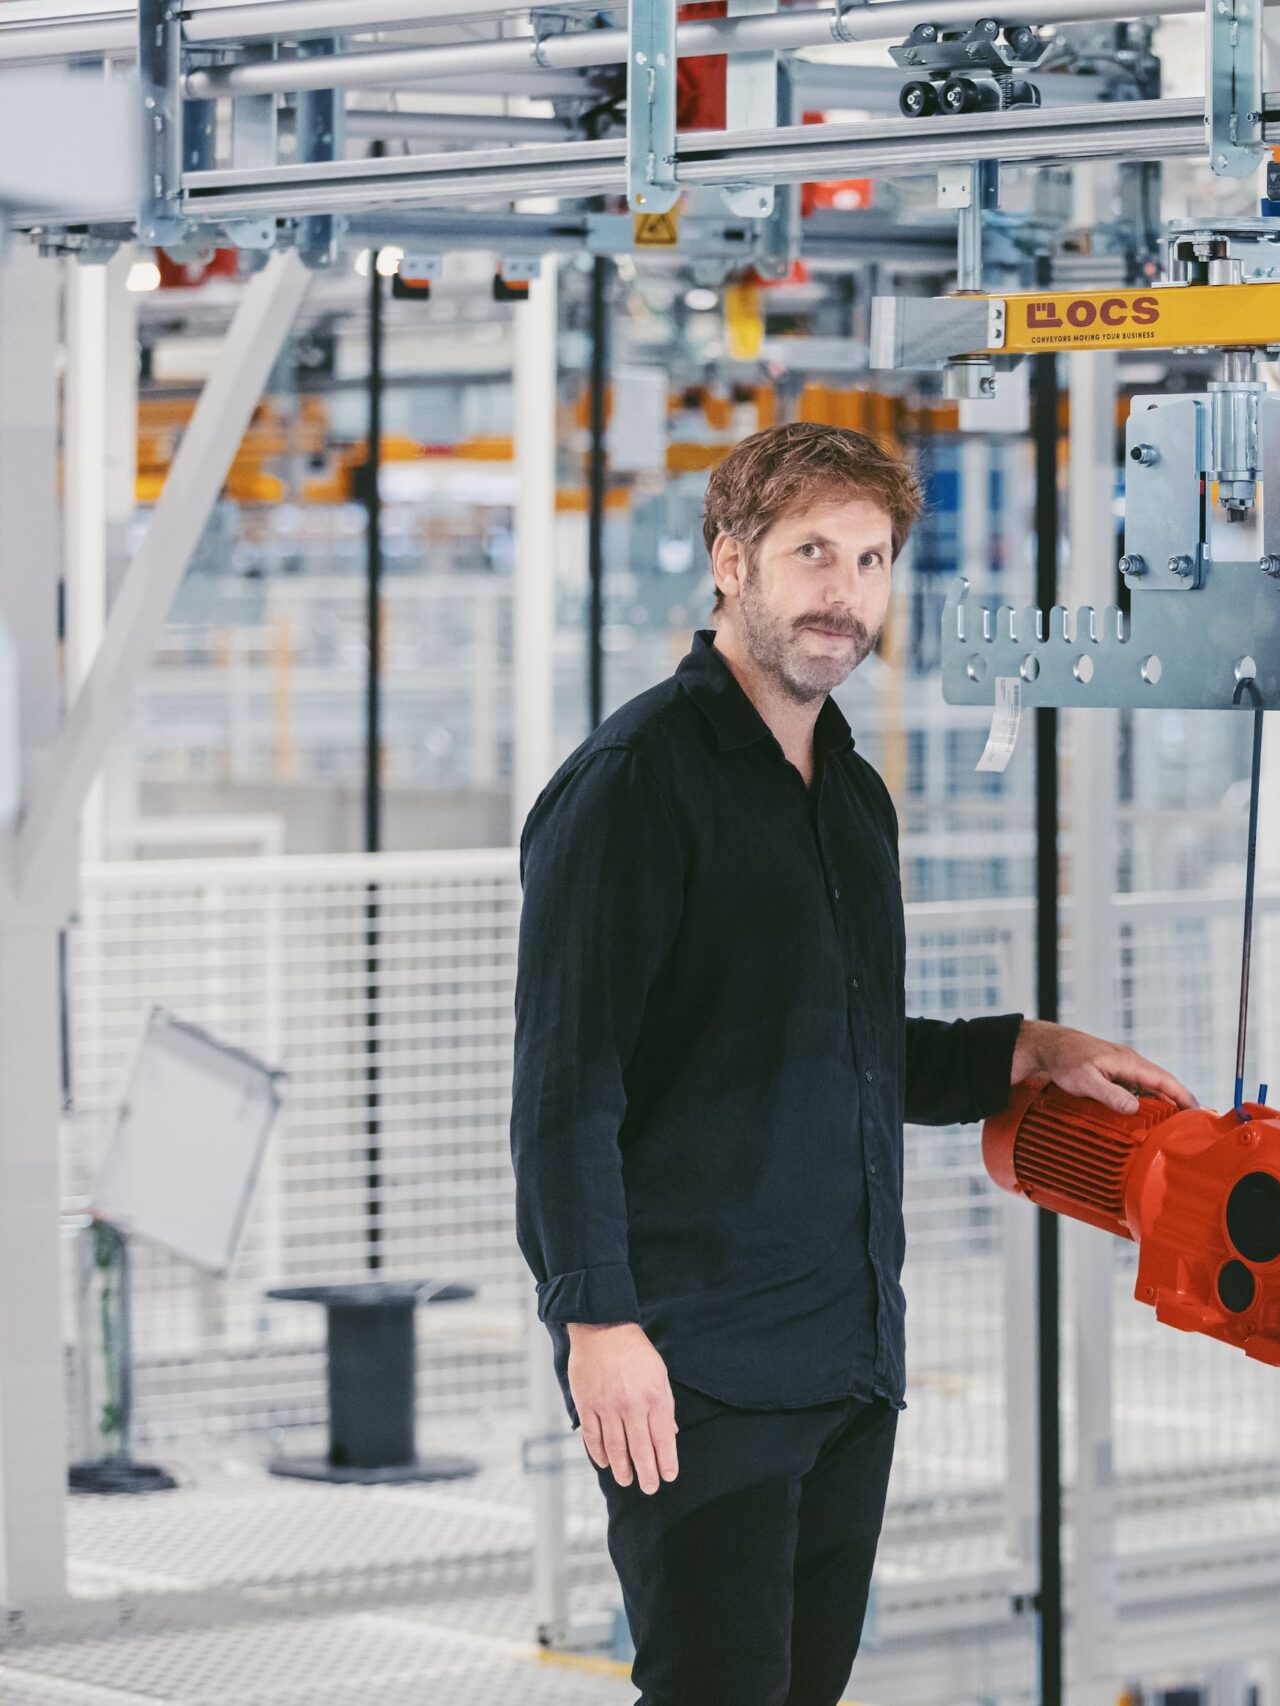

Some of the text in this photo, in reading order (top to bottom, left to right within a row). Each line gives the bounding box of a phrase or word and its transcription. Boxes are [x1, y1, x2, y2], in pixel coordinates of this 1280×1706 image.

[1031, 331, 1155, 344] CONVEYORS MOVING YOUR BUSINESS
